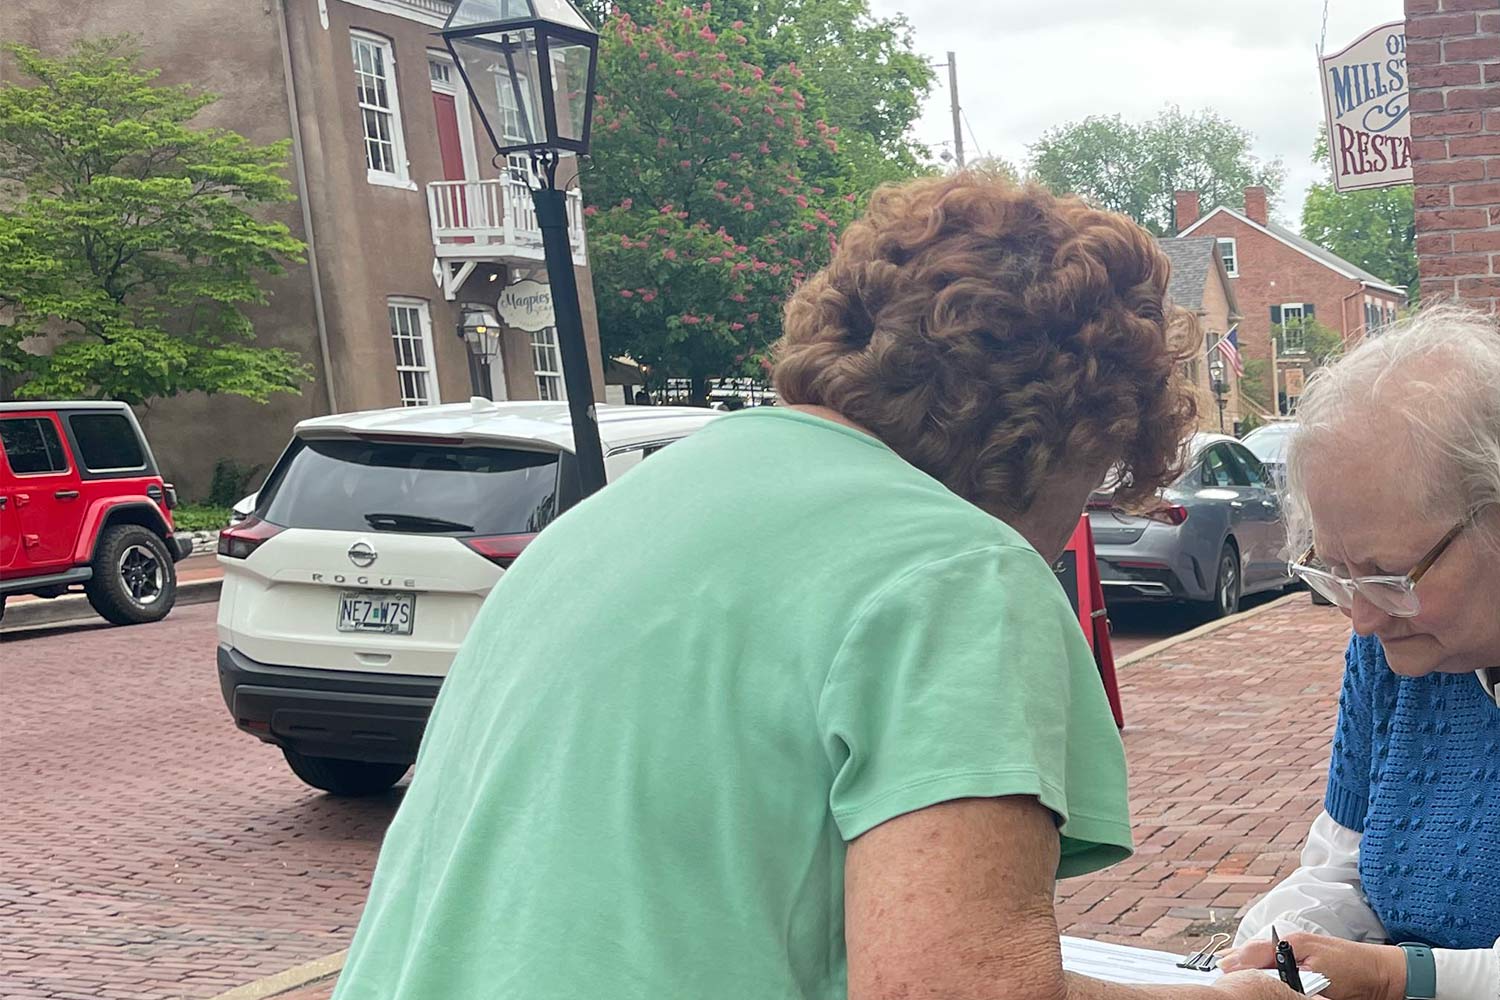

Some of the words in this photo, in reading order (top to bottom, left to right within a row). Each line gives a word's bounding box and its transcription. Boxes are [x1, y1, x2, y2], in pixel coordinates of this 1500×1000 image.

[1329, 59, 1408, 119] MILLS
[312, 573, 415, 587] ROGUE
[342, 600, 372, 622] NE7
